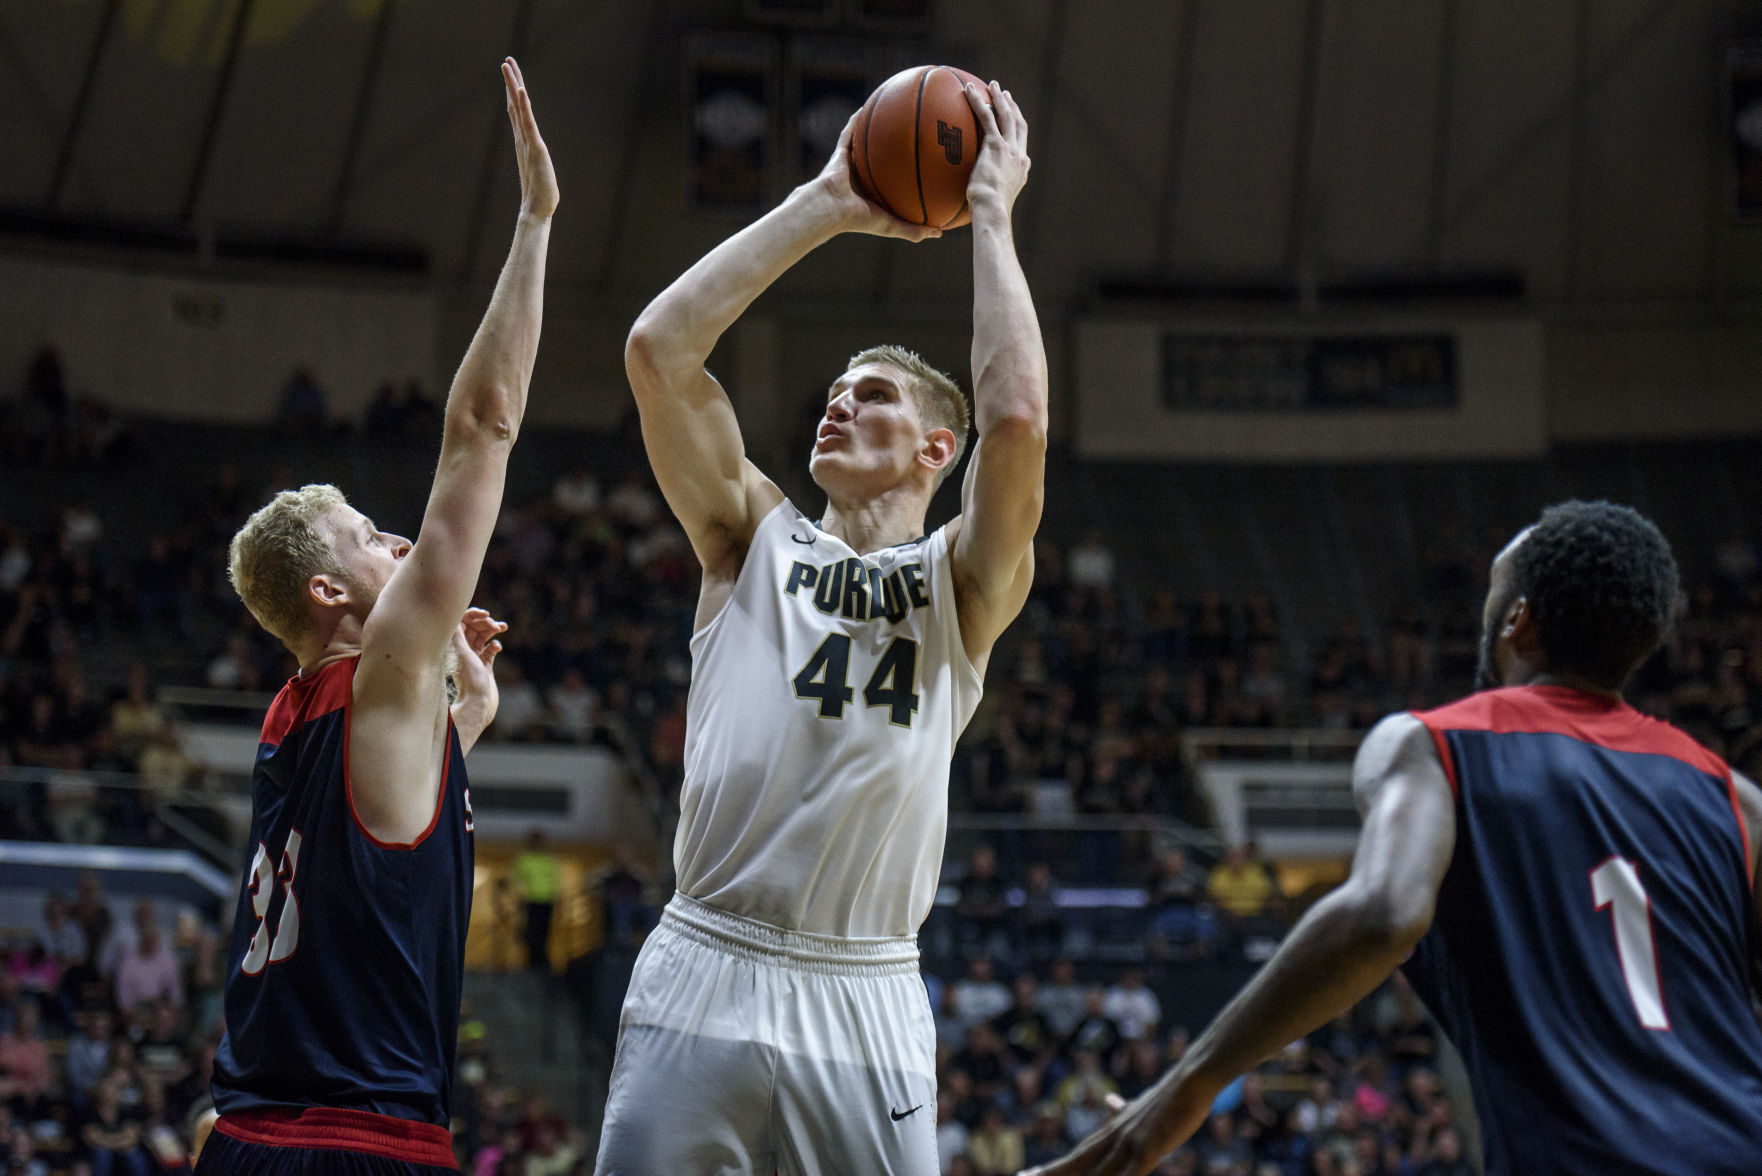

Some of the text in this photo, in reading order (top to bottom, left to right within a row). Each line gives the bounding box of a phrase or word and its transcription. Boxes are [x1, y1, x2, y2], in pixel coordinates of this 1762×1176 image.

[784, 557, 930, 624] PURDUE
[792, 632, 919, 729] 44
[241, 825, 302, 977] 33
[1588, 855, 1672, 1031] 1
